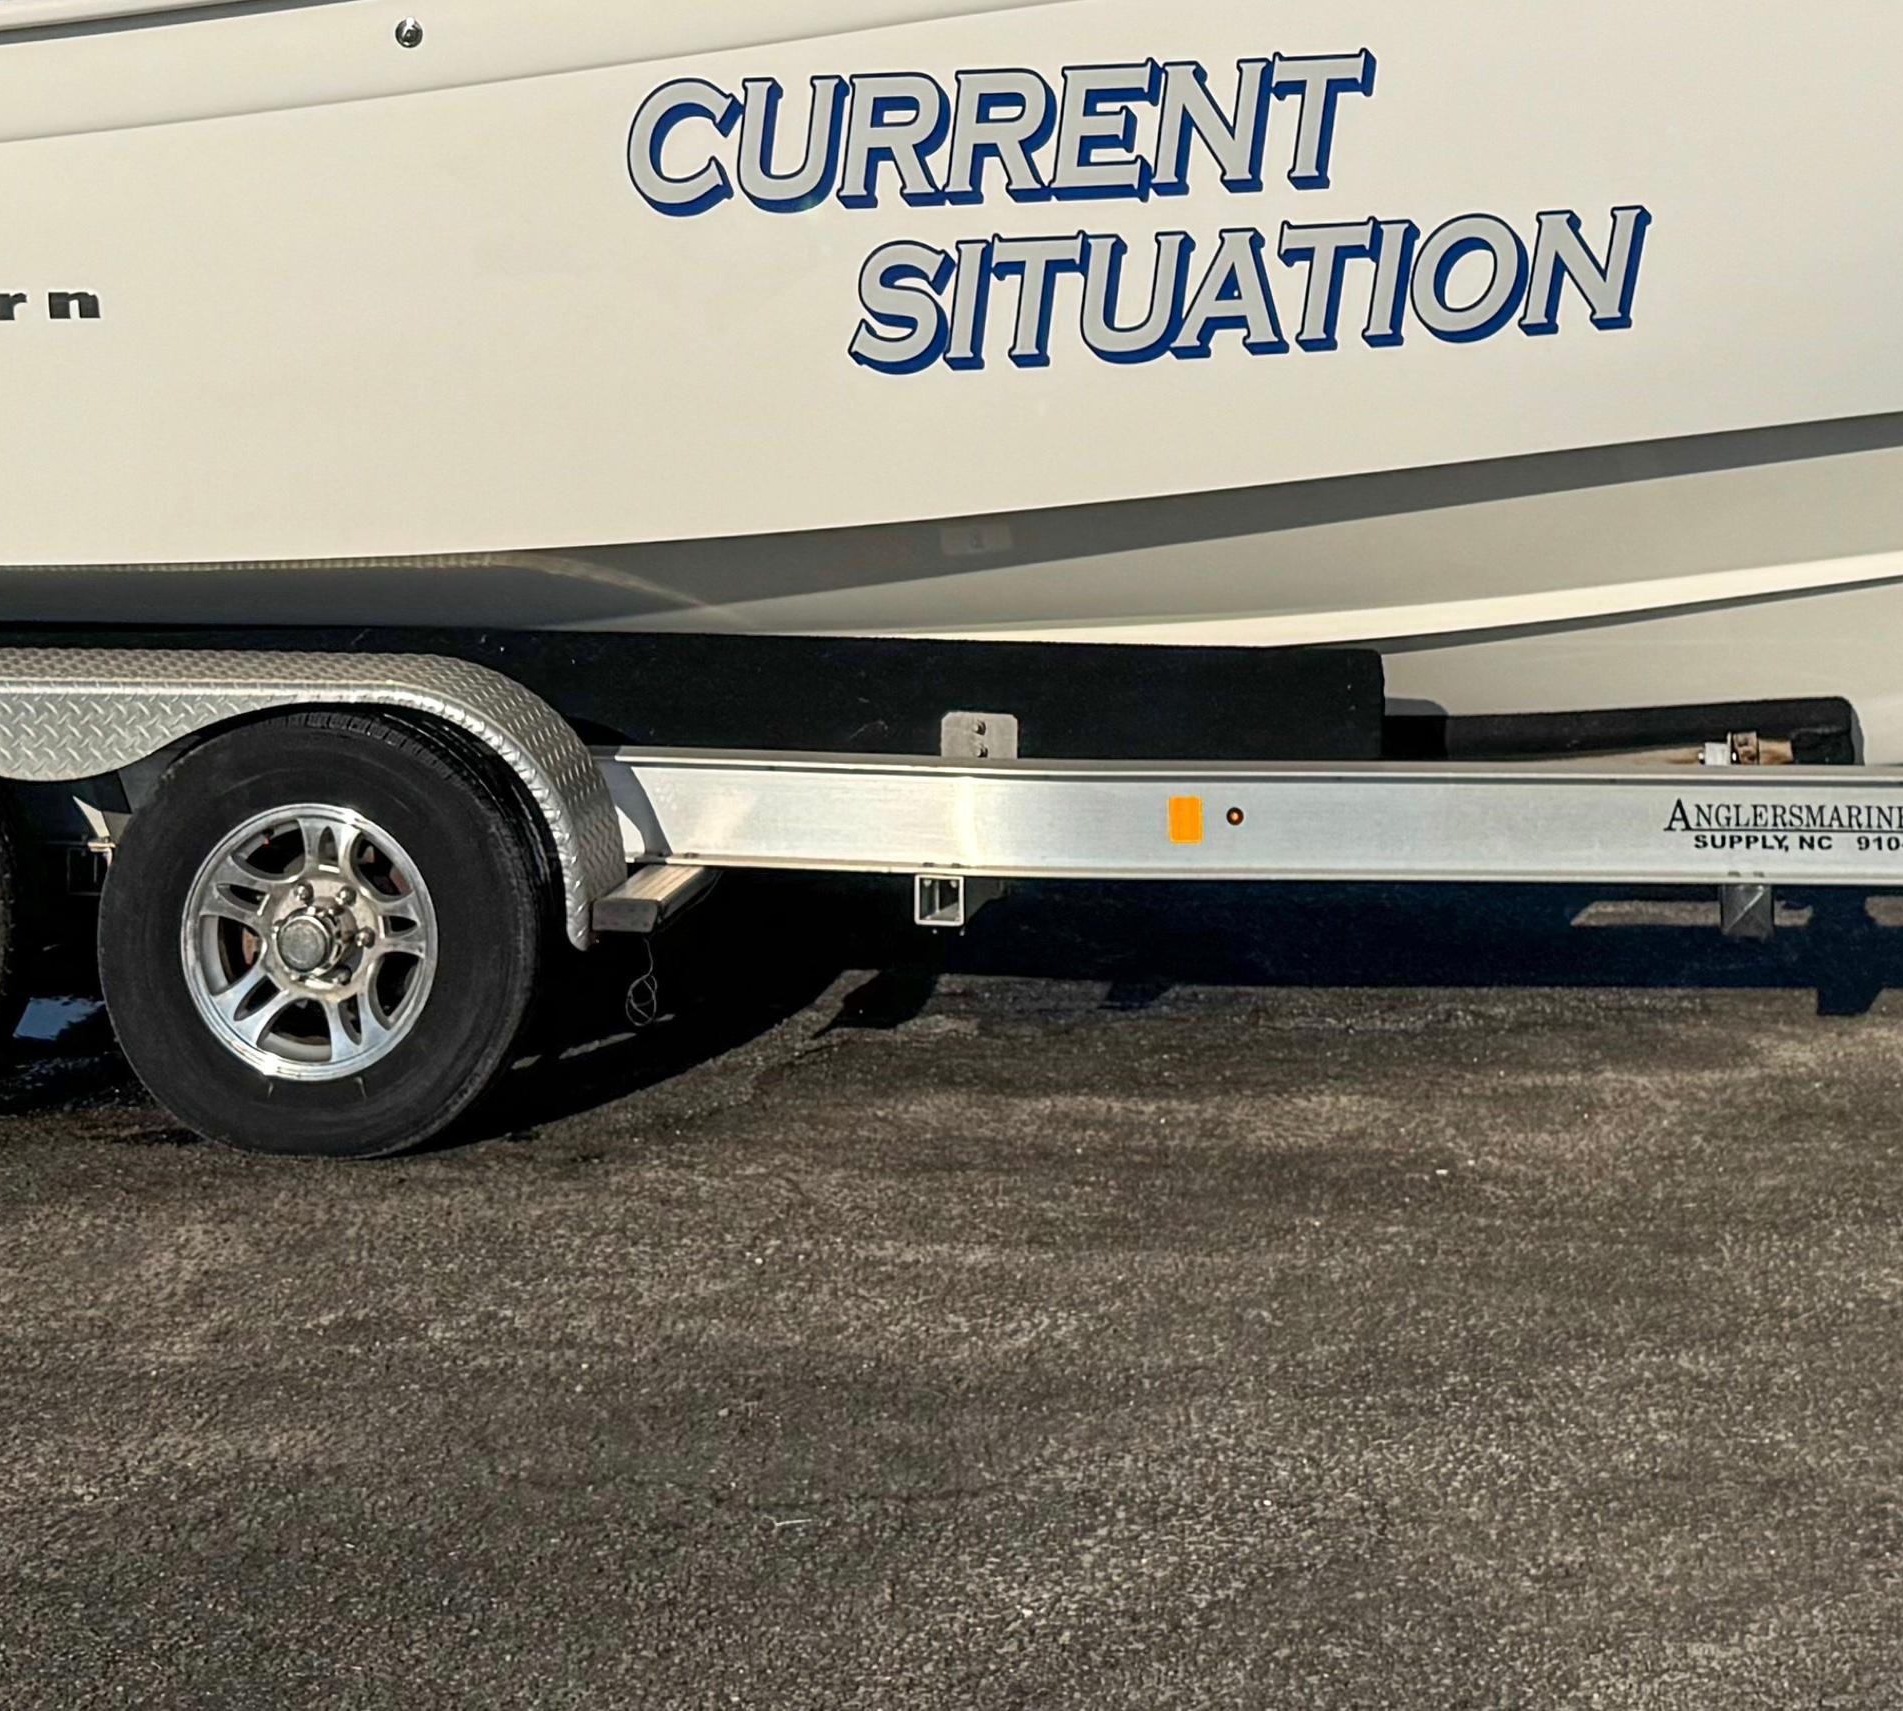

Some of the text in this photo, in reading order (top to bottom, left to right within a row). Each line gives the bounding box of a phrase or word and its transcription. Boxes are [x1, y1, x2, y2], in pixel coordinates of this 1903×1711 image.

[626, 48, 1376, 217] CURRENT
[847, 205, 1652, 375] SITUATION
[1694, 834, 1789, 852] SUPPLY,
[1799, 835, 1833, 850] NC
